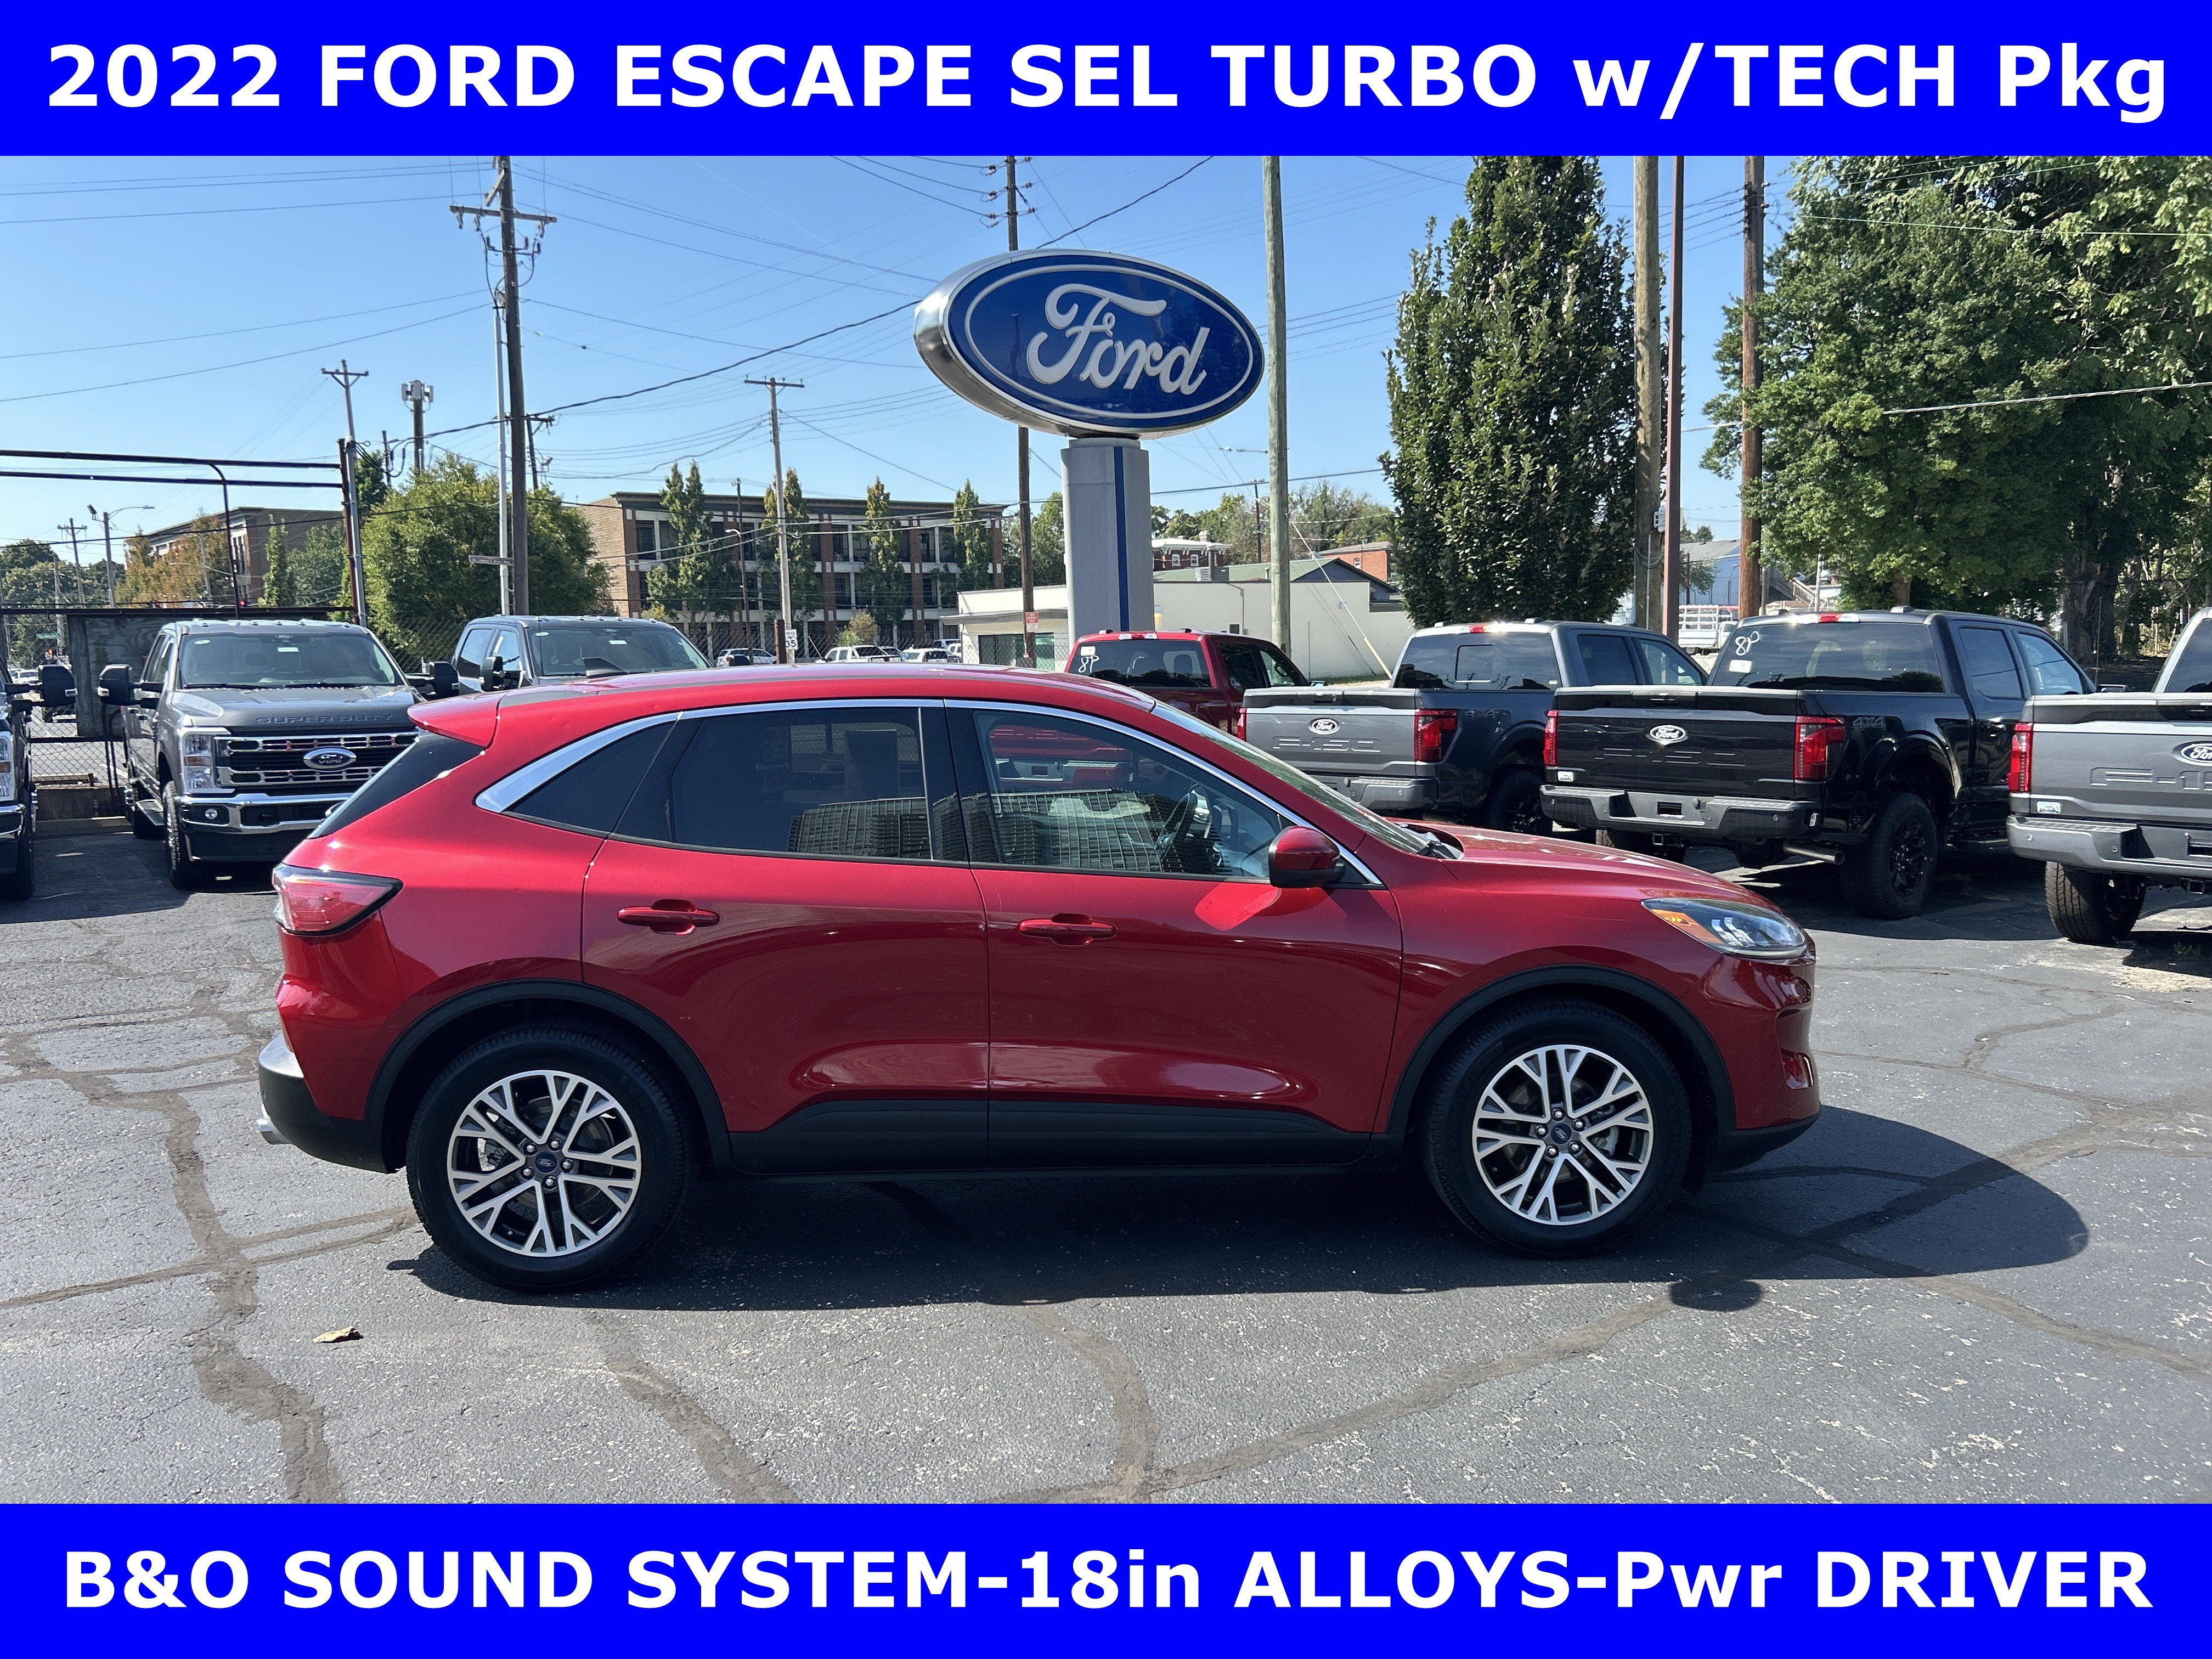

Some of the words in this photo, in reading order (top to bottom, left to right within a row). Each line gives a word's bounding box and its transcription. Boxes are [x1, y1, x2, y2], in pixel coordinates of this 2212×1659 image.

[1026, 283, 1211, 396] Ford
[785, 640, 797, 648] 35
[256, 716, 334, 725] SUPER
[337, 714, 393, 723] DUTY
[1315, 720, 1334, 731] Ford
[1655, 727, 1680, 739] Ford
[1272, 736, 1381, 753] F-150
[318, 754, 343, 764] Ford
[1593, 745, 1747, 767] F-150
[2090, 766, 2212, 792] F-1
